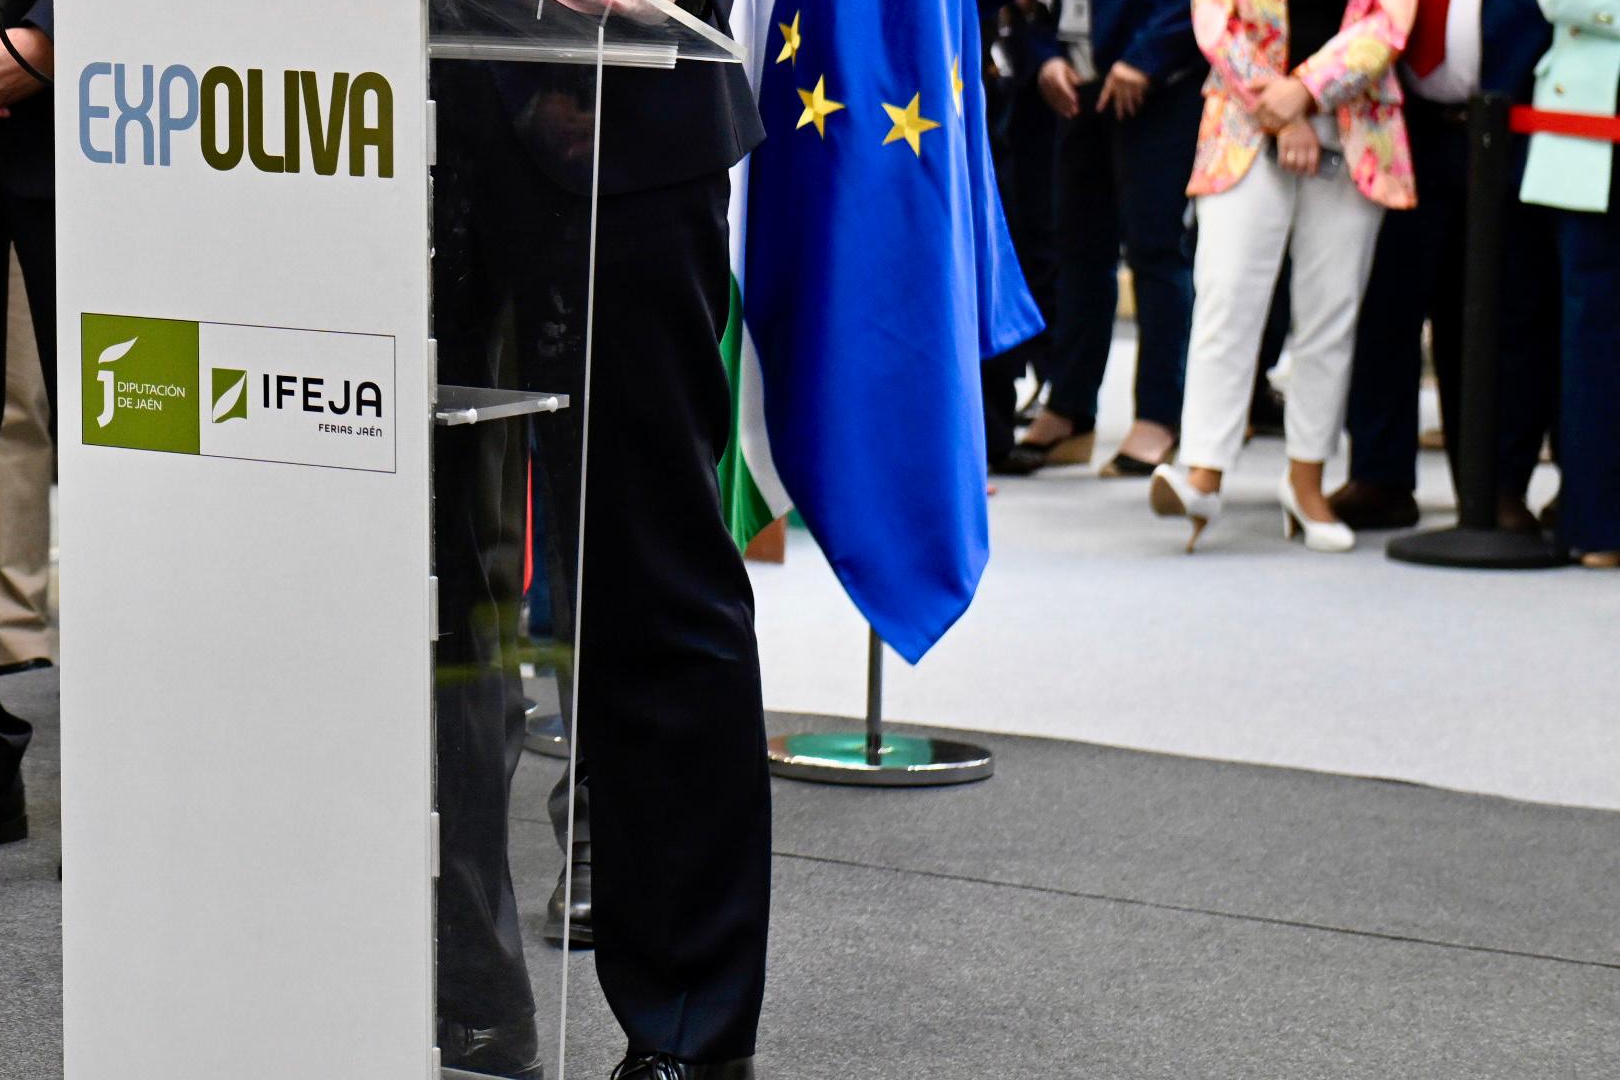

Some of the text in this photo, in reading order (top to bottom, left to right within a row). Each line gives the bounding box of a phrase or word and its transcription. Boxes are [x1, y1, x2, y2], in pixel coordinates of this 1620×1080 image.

[78, 61, 394, 178] EXPOLIVA
[117, 380, 186, 399] DIPUTACIÓN
[263, 373, 383, 418] IFEJA
[117, 396, 162, 411] DE JAÉN
[318, 423, 383, 438] FERIAS JAÉN
